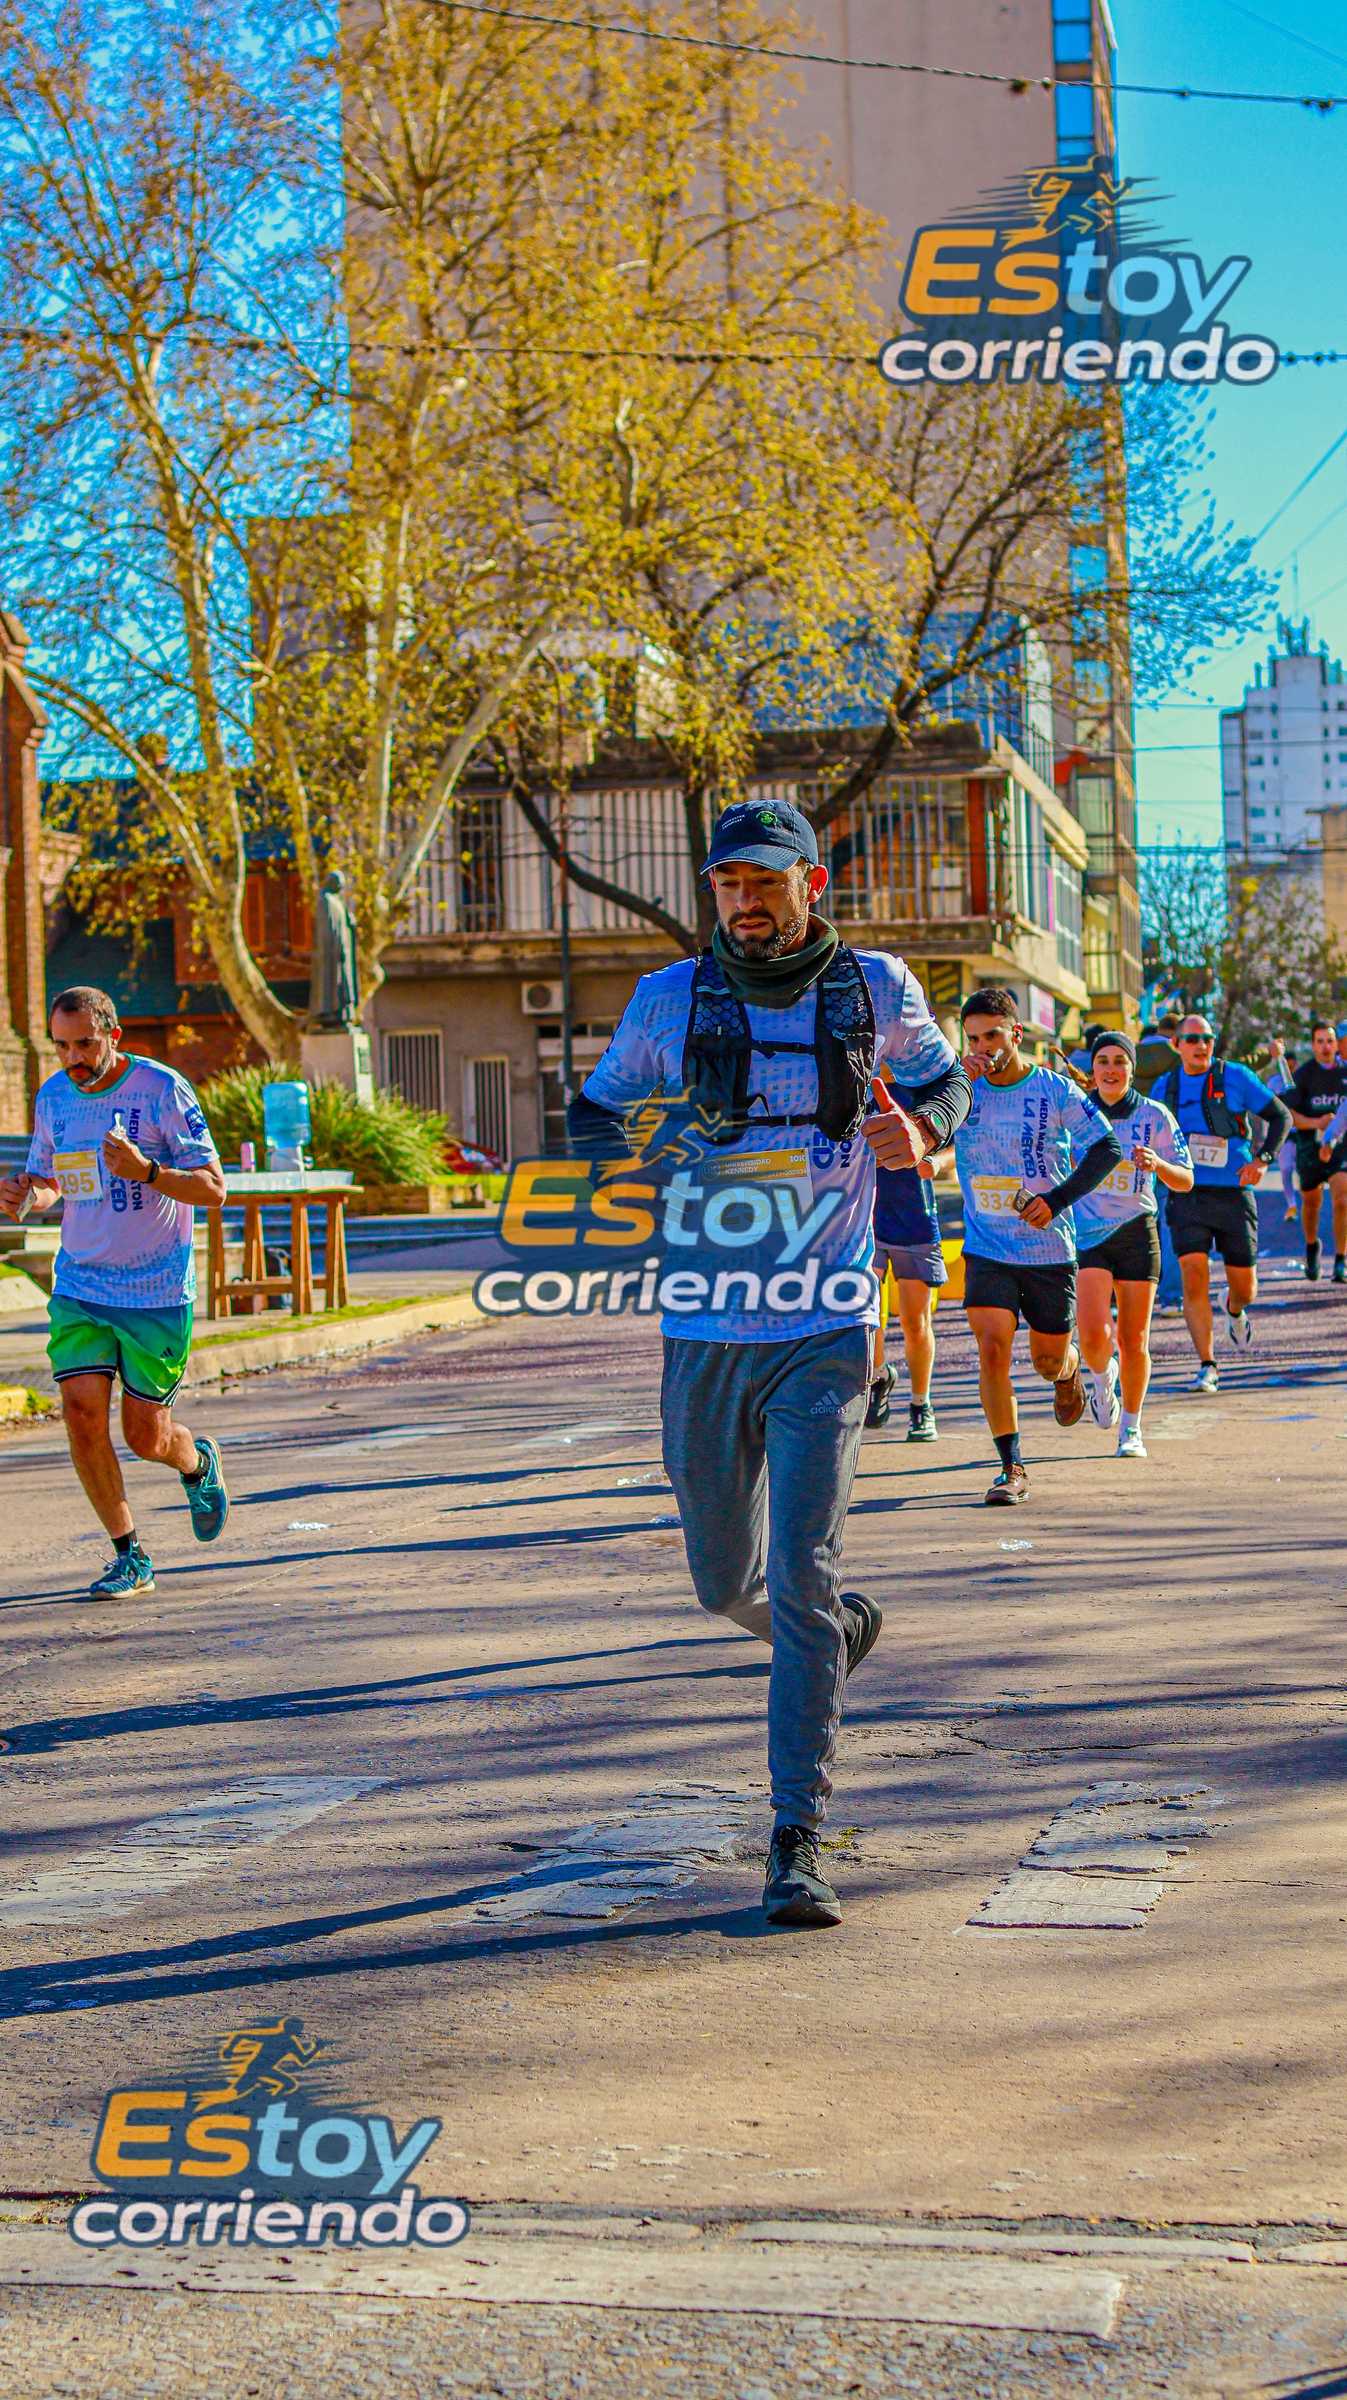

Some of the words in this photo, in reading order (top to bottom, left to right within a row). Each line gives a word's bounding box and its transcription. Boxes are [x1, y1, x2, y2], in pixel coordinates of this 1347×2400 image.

[1023, 1098, 1036, 1118] LA
[1039, 1098, 1049, 1131] MEDIA
[1021, 1122, 1037, 1179] MERCED
[1198, 1148, 1219, 1162] 17
[59, 1172, 95, 1194] 295
[810, 1405, 847, 1415] adidas
